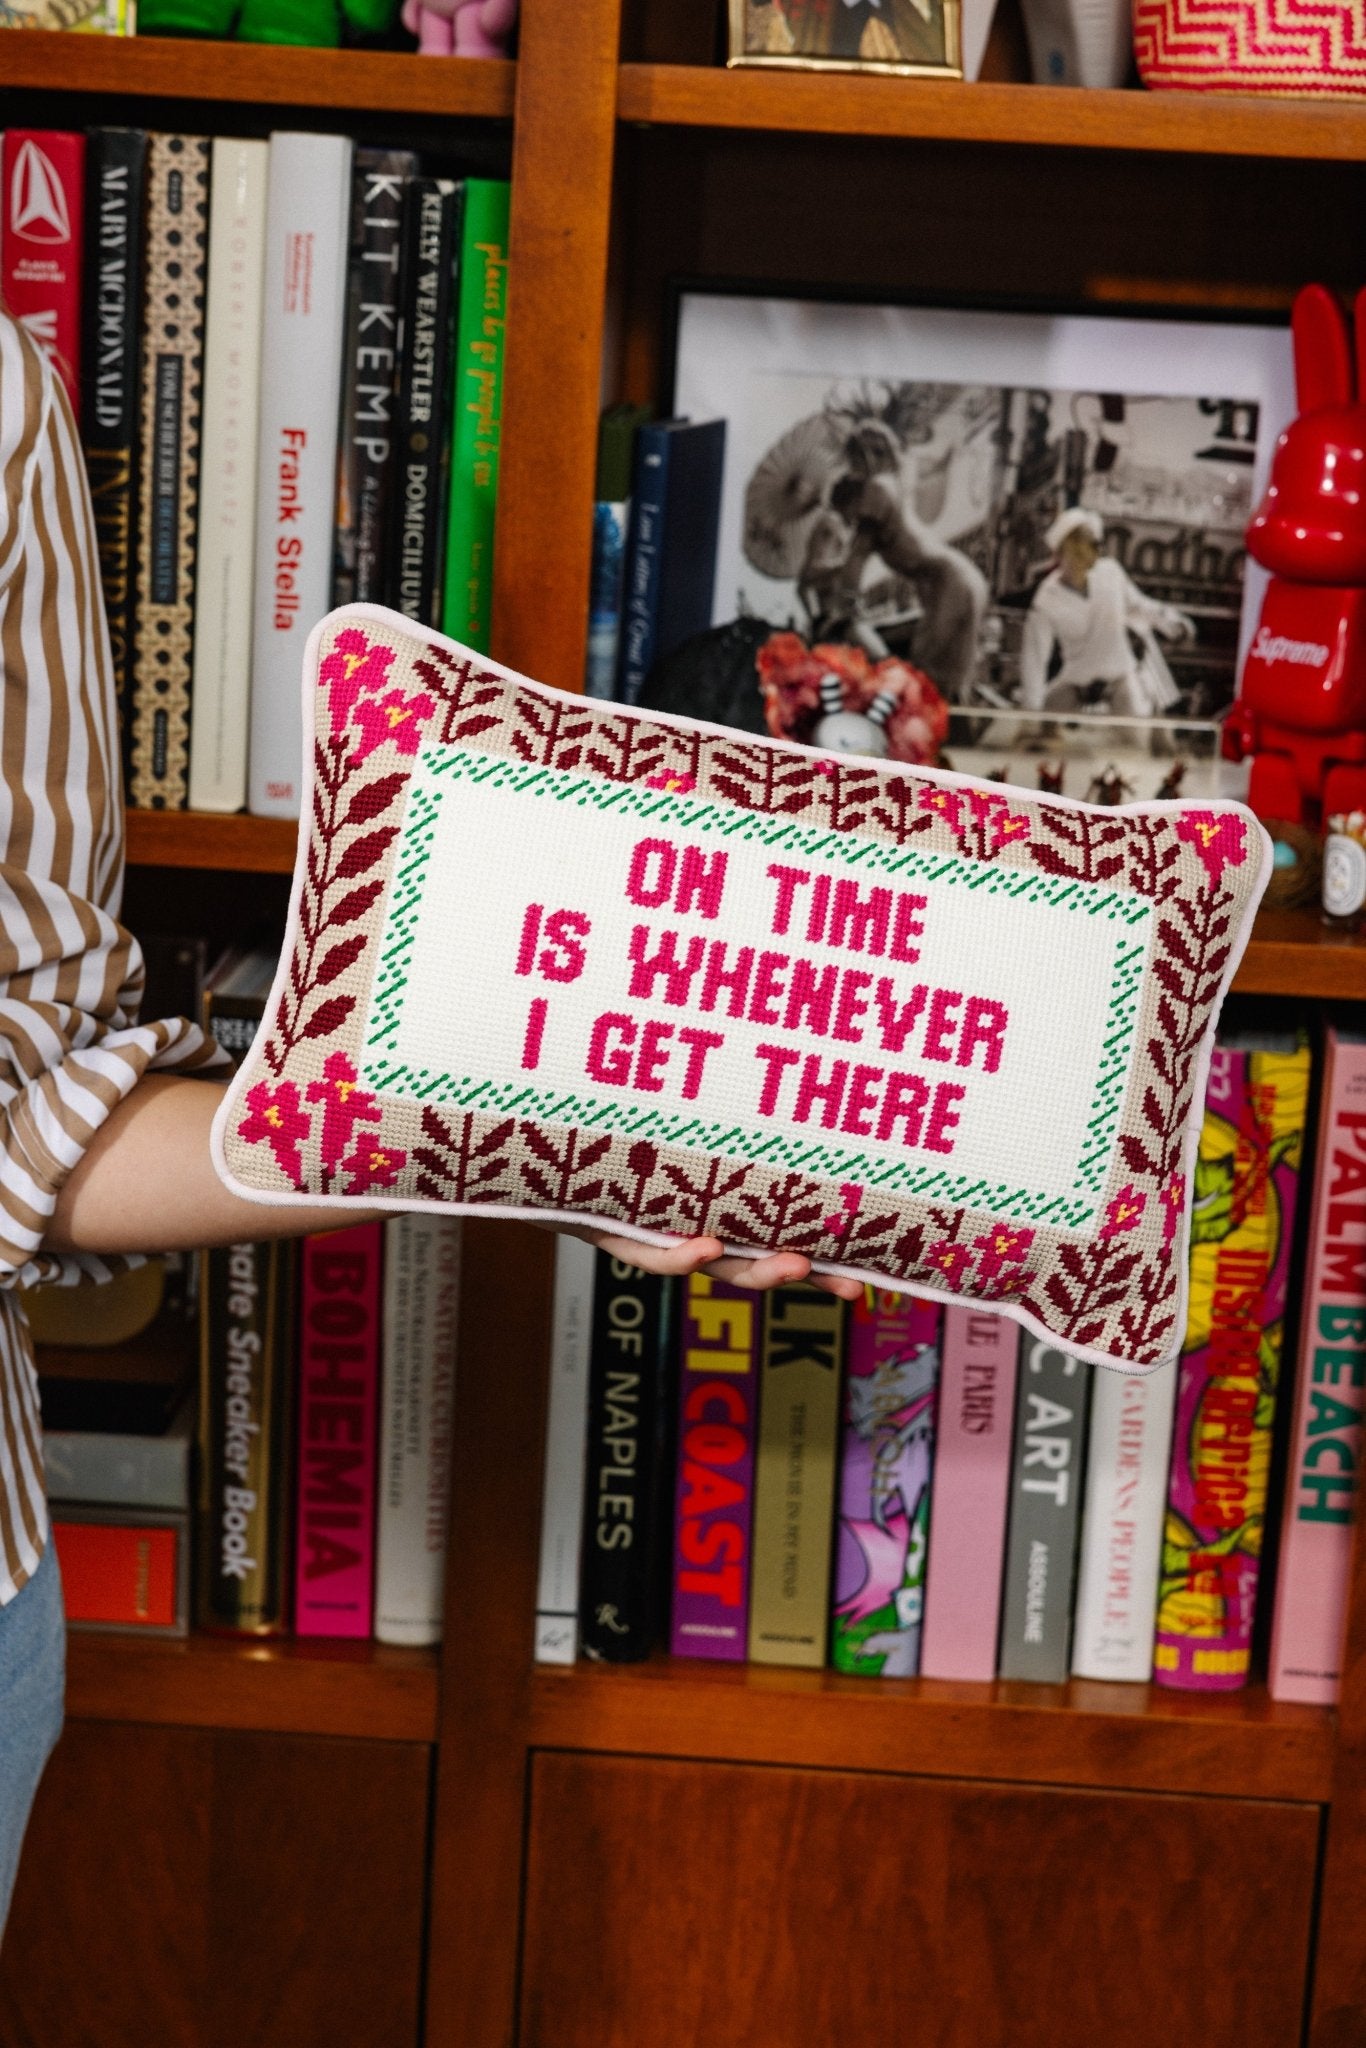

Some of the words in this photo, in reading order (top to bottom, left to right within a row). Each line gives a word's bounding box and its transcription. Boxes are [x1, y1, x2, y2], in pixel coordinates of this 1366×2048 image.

[99, 165, 129, 251] MARY
[363, 173, 400, 273] KIT
[420, 193, 444, 265] KELLY
[95, 259, 127, 427] MCDONALD
[353, 303, 395, 464] KEMP
[409, 271, 439, 423] WEARSTLER
[277, 428, 307, 523] Frank
[273, 536, 304, 632] Stella
[400, 464, 429, 621] DOMICILIUM
[1251, 627, 1329, 667] Supreme
[625, 837, 729, 919] ON
[766, 863, 928, 963] TIME
[515, 903, 591, 984] IS
[627, 924, 1009, 1074] WHENEVER
[521, 997, 548, 1071] I
[584, 1011, 725, 1101] GET
[755, 1043, 966, 1154] THERE
[606, 1297, 646, 1357] OF
[225, 1328, 262, 1477] Sneaker
[304, 1250, 368, 1581] BOHEMIA
[961, 1365, 997, 1436] PARIS
[1021, 1393, 1073, 1507] ART
[1298, 1304, 1366, 1526] BEACH
[596, 1371, 640, 1551] NAPLES
[678, 1380, 748, 1606] COAST
[220, 1486, 258, 1581] Book
[1023, 1540, 1049, 1644] ASSOULINE
[1102, 1520, 1139, 1627] PEOPLE
